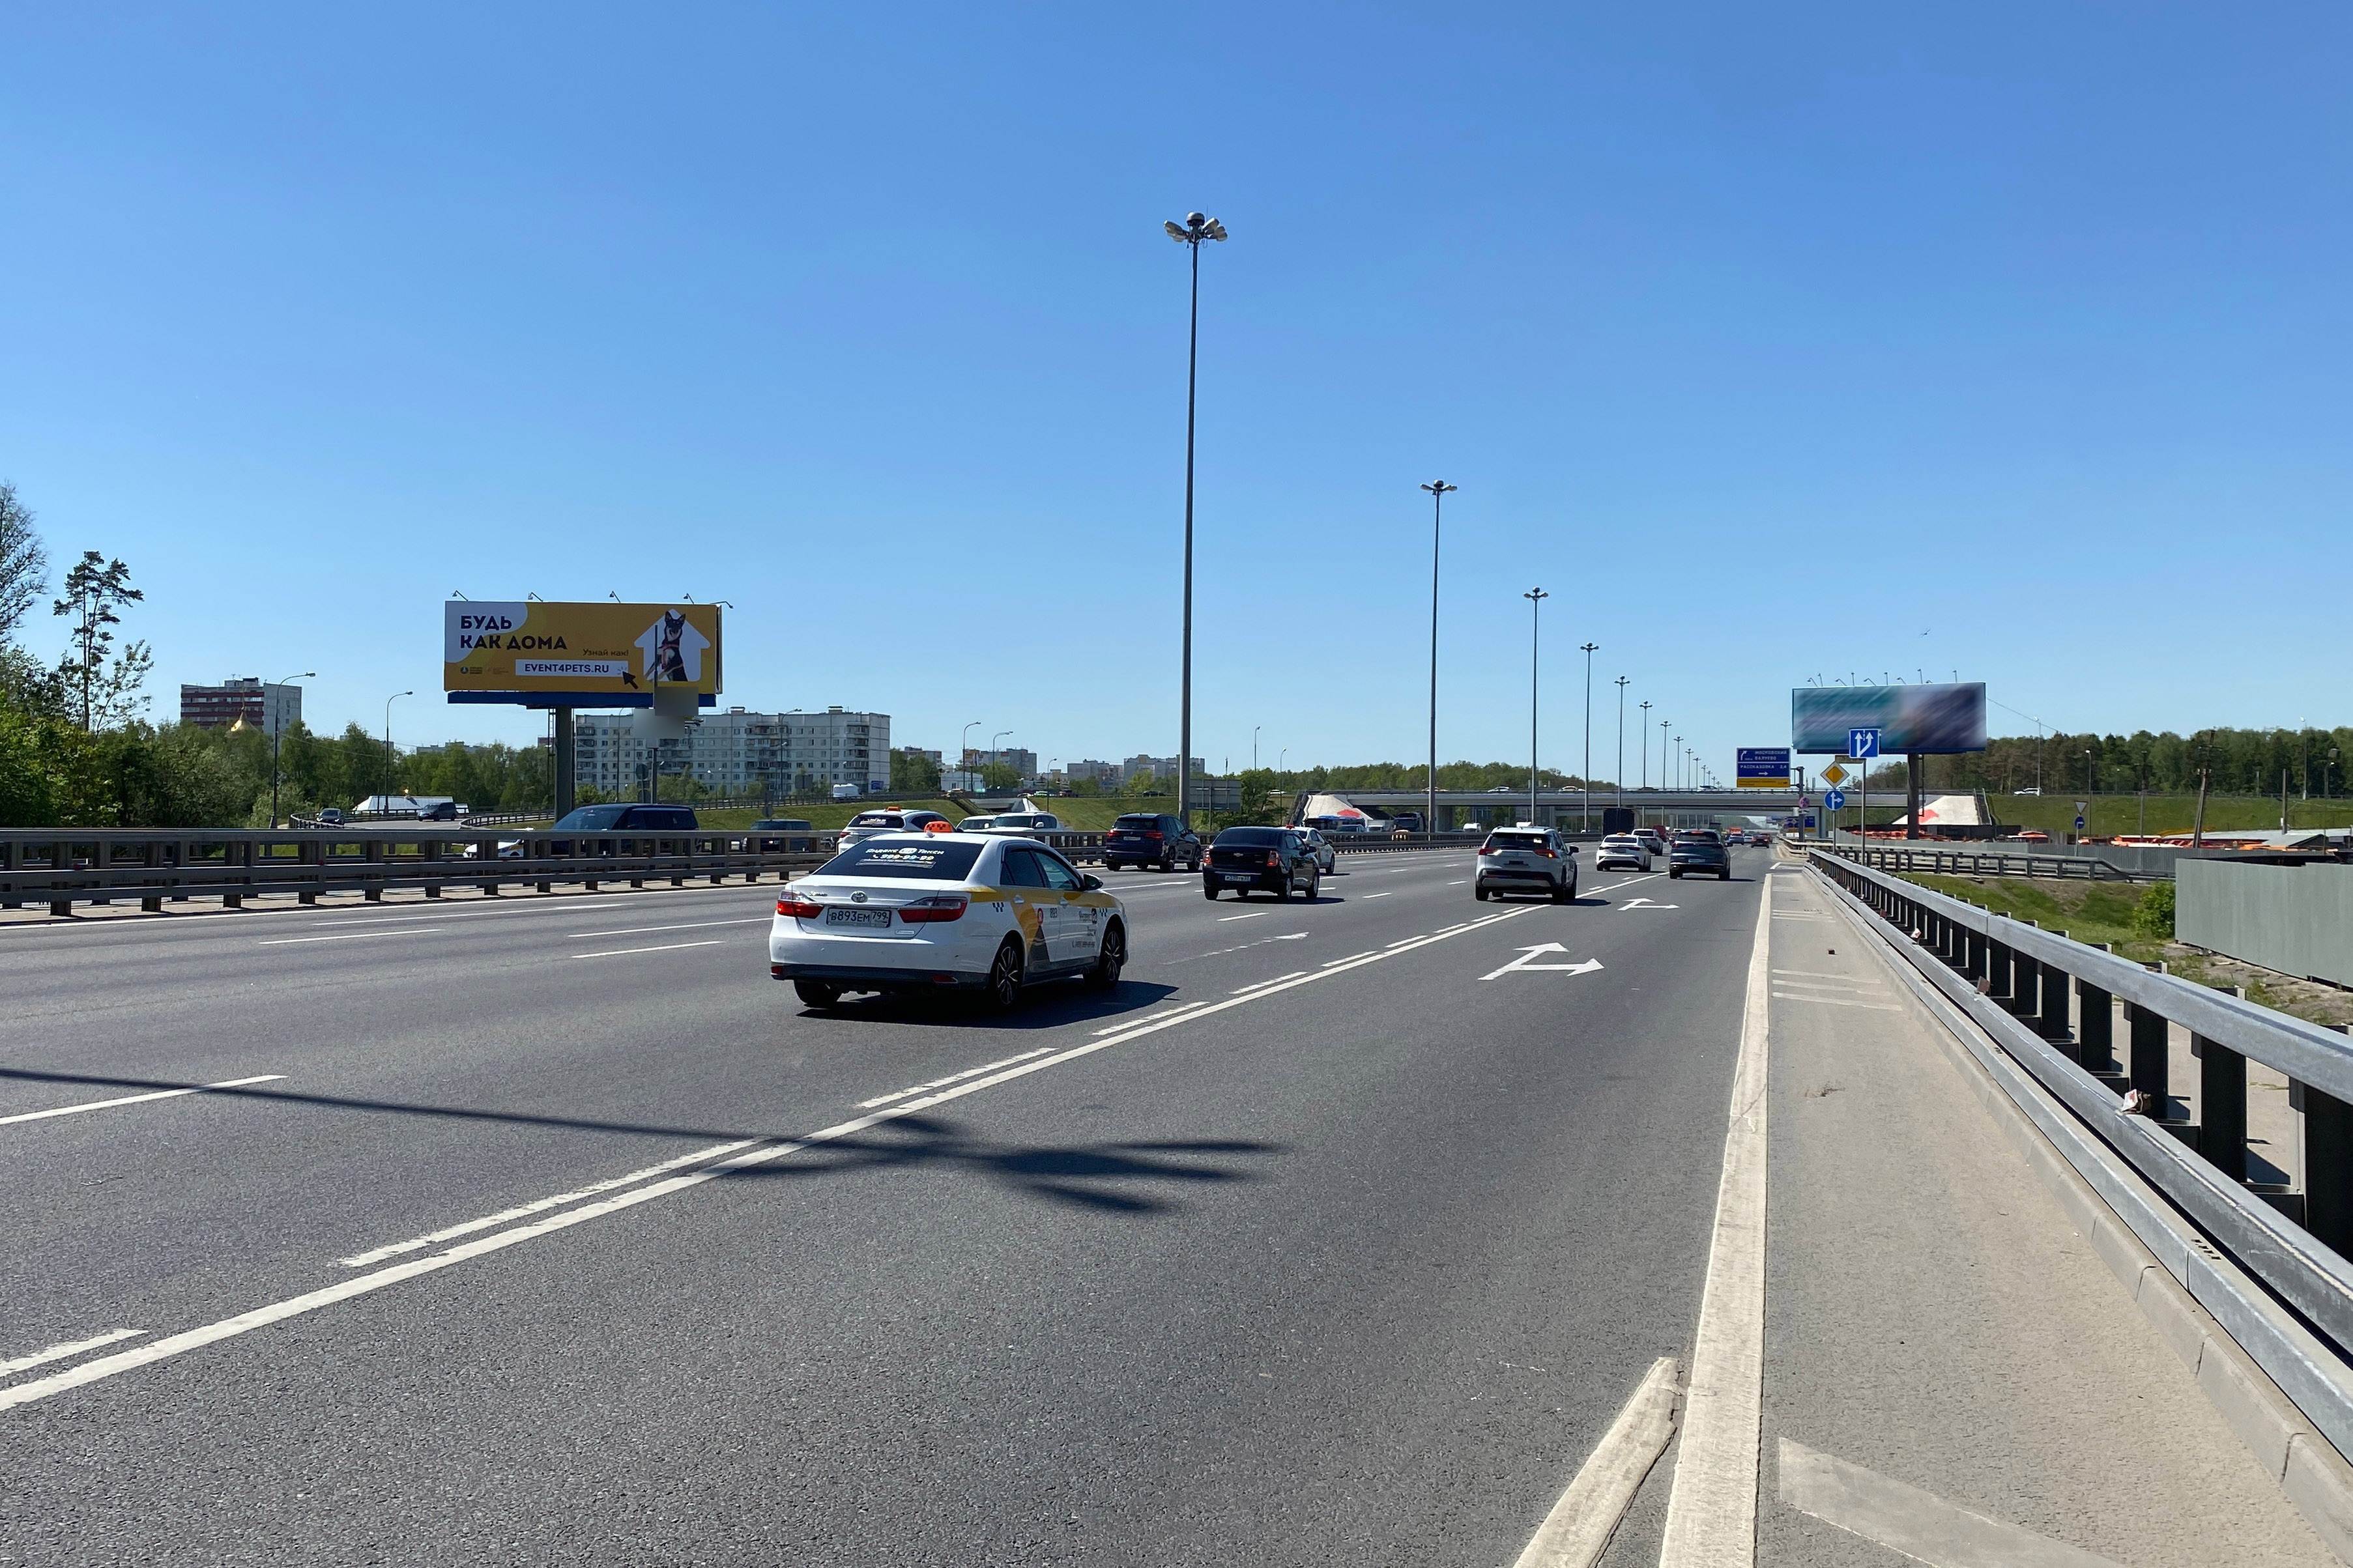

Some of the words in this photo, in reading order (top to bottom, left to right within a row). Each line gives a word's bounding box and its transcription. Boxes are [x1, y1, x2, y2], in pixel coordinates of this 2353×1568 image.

[461, 615, 512, 631] БУДЬ
[460, 634, 501, 649] КАК
[506, 635, 568, 650] ДОМА
[525, 663, 609, 673] EVENT4PETS.RU
